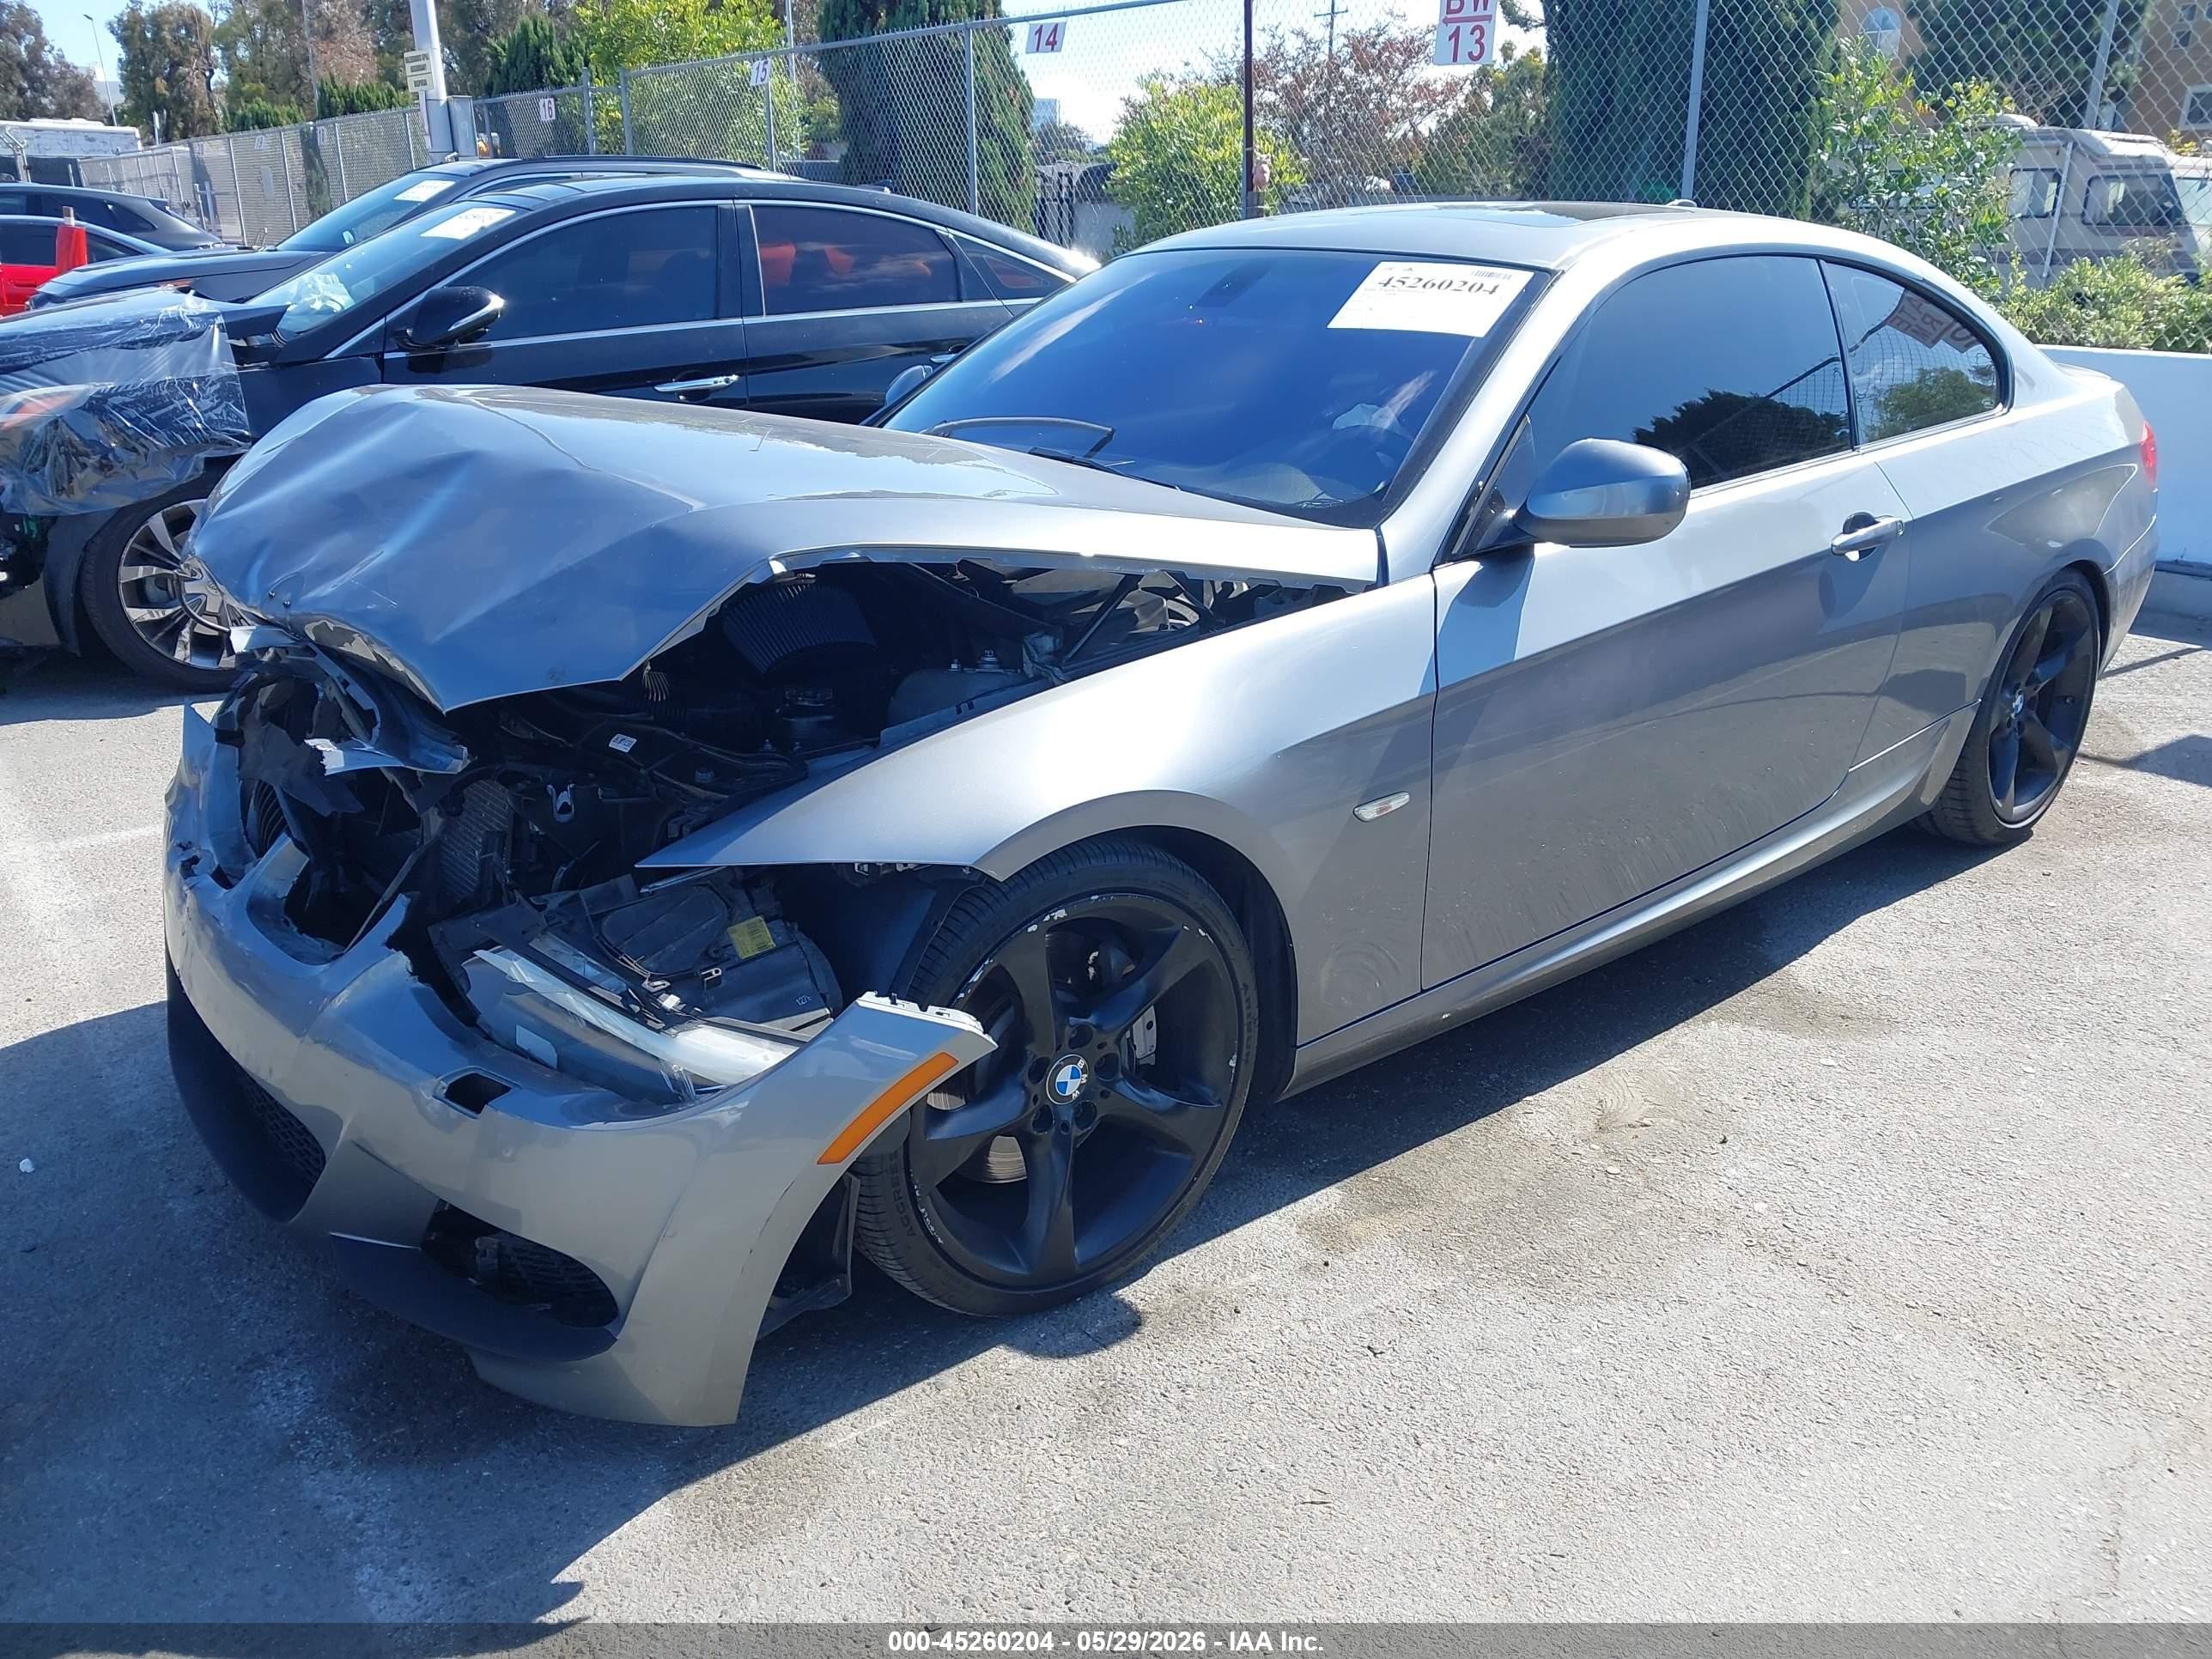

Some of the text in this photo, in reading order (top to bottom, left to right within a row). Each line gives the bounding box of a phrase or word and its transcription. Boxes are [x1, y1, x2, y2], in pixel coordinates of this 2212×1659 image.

[1034, 22, 1059, 52] 14
[1448, 24, 1486, 64] 13
[755, 60, 769, 84] 15
[542, 99, 554, 119] 16
[1377, 275, 1500, 295] 45260204
